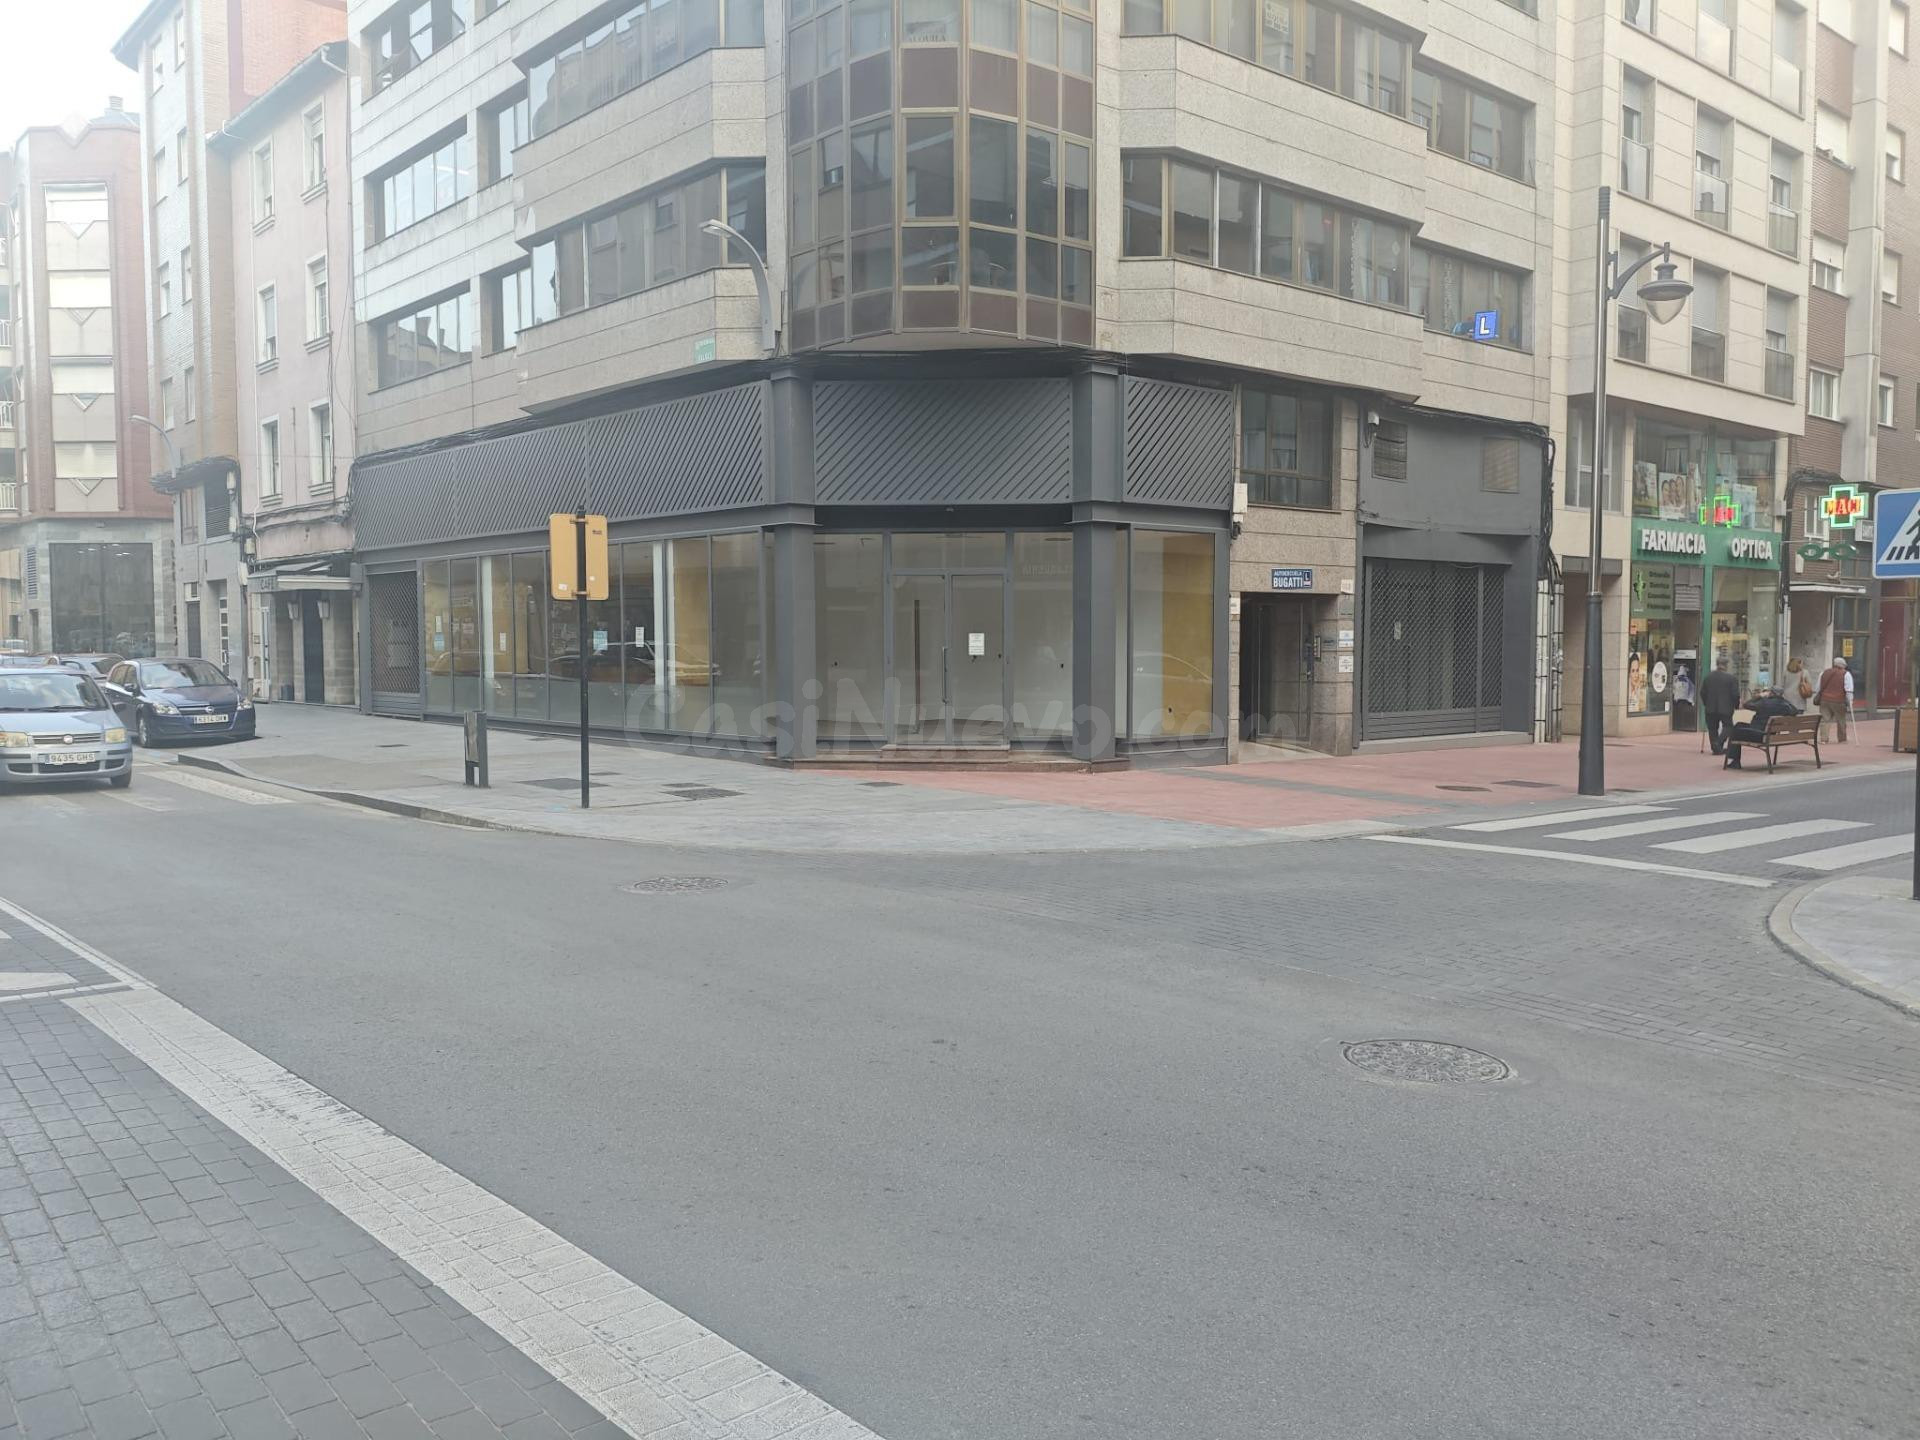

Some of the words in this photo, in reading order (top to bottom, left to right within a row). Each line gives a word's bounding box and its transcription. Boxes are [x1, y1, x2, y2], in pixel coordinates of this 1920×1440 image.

[1479, 316, 1491, 336] L
[1641, 528, 1706, 555] FARMACIA
[1731, 537, 1773, 560] OPTICA
[1273, 577, 1303, 588] BUGATTI
[51, 754, 74, 762] 9435
[76, 753, 95, 761] GHS
